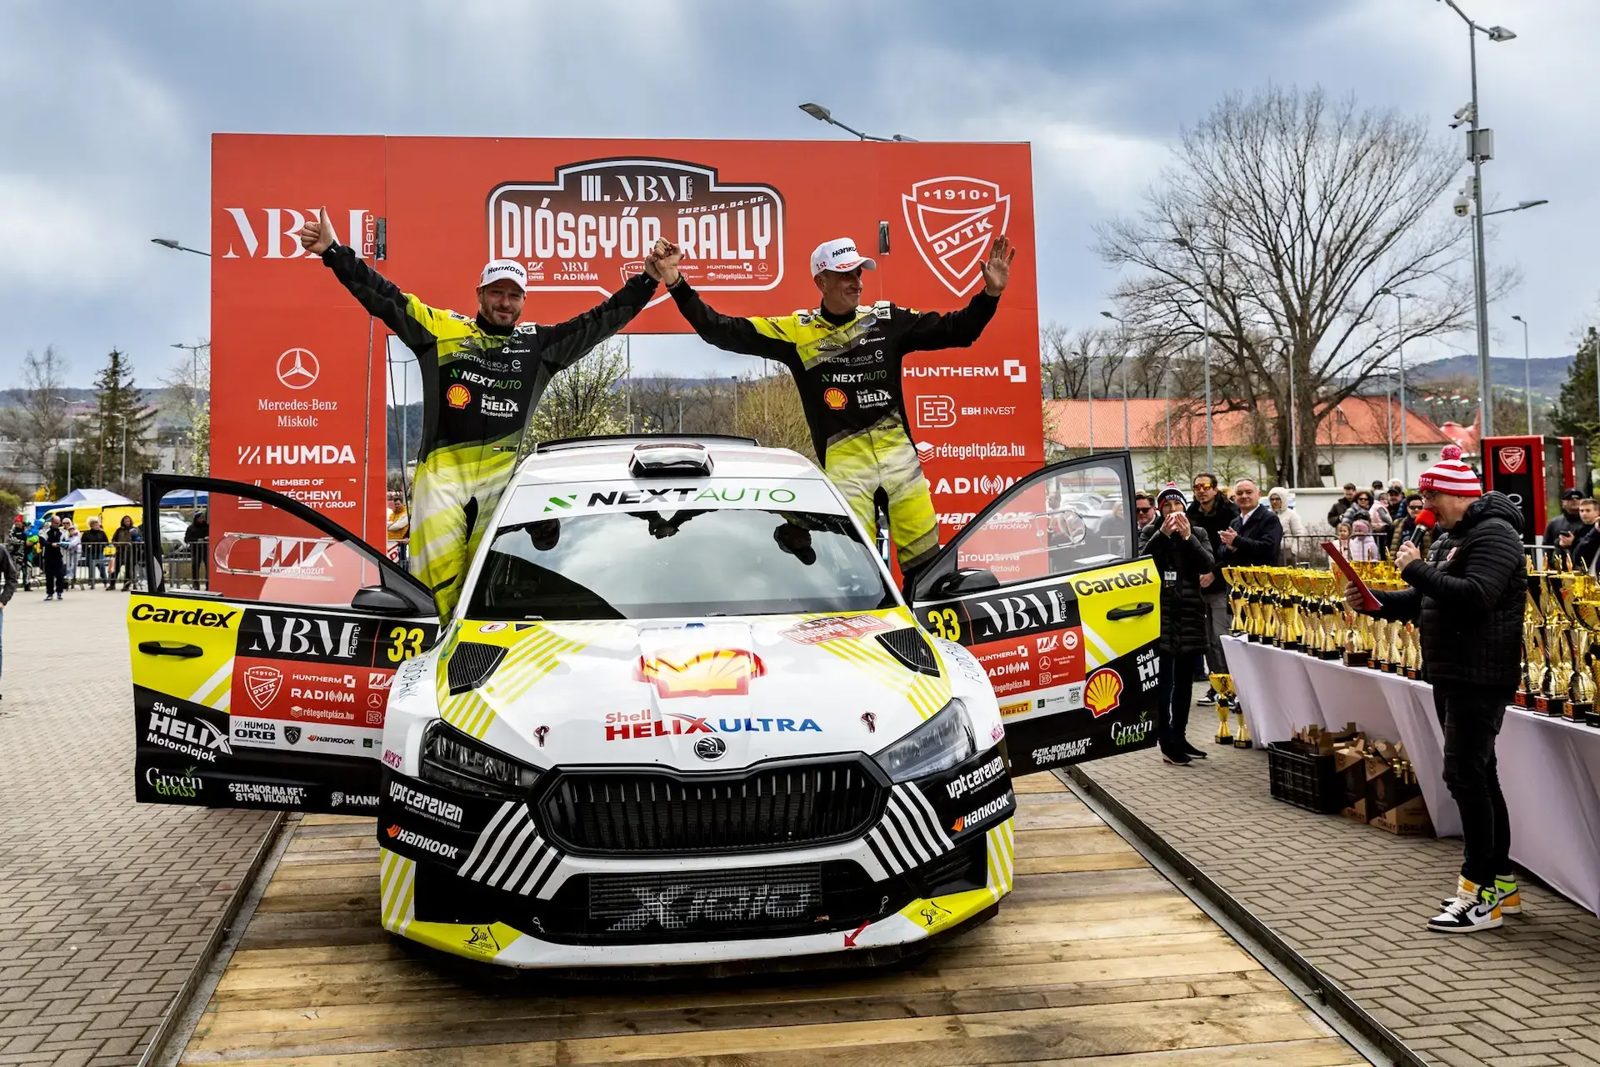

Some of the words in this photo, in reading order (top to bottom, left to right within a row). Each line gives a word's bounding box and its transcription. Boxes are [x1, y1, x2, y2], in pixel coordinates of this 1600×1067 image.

[581, 175, 611, 202] III.
[932, 189, 981, 201] 1910
[363, 214, 375, 255] Rent
[501, 197, 662, 259] DIÓSGYŐR
[677, 203, 771, 260] RALLY
[932, 217, 994, 255] DVTK
[903, 366, 999, 378] HUNTHERM
[258, 399, 337, 412] Mercedes-Benz
[857, 389, 892, 404] HELIX
[481, 399, 519, 413] HELIX
[961, 407, 980, 415] EBH
[983, 406, 1016, 415] INVEST
[278, 416, 318, 427] Miskolc
[266, 445, 356, 465] HUMDA
[936, 442, 1026, 461] rétegeltpláza.hu
[1074, 568, 1154, 596] Cardex
[131, 603, 238, 629] Cardex
[928, 608, 961, 642] 33
[349, 626, 361, 656] Rent
[387, 626, 425, 663] 33
[1136, 648, 1155, 665] Shell
[292, 674, 342, 684] HUNTHERM
[252, 681, 276, 696] DVTK
[153, 702, 178, 717] Shell
[303, 708, 355, 721] rétegeltpláza.hu
[605, 709, 652, 723] Shell
[149, 711, 233, 756] HELIX
[234, 729, 276, 741] ORB
[244, 721, 276, 731] HUMDA
[604, 712, 718, 741] HELIX
[718, 718, 823, 733] ULTRA
[1111, 719, 1153, 741] Green
[146, 732, 217, 763] Motorolajok
[145, 767, 204, 790] Green
[155, 778, 196, 798] Grass
[228, 783, 286, 796] SZIK-NORMA
[286, 787, 307, 797] KFT.
[235, 792, 262, 802] 8194
[263, 793, 301, 805] VILONYA
